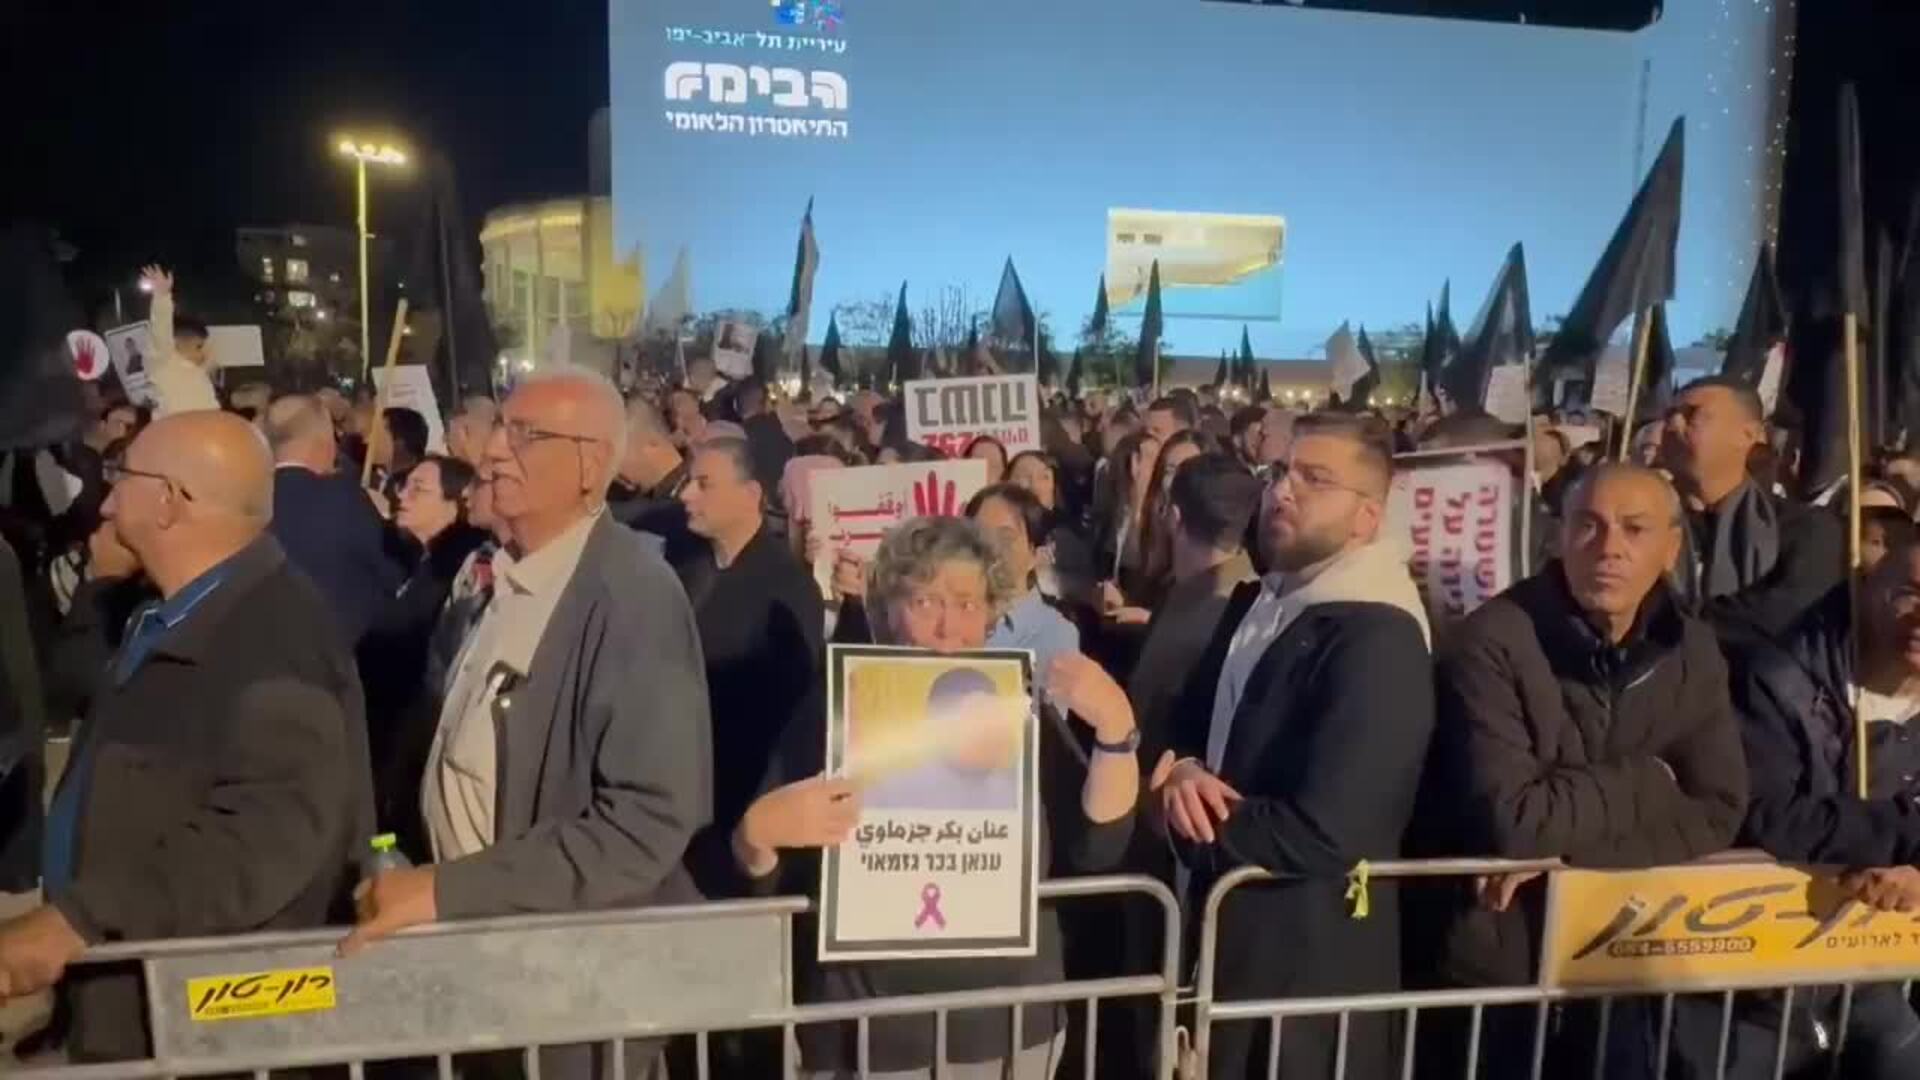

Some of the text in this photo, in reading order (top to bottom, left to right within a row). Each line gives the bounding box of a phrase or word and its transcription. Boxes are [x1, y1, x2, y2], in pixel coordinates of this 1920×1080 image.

[787, 35, 847, 53] עיריית
[665, 110, 847, 138] התיאטרון הלאומי
[855, 819, 1009, 848] عنان بكر جزماوي
[861, 852, 1002, 874] ענאן בכר גזמאוי
